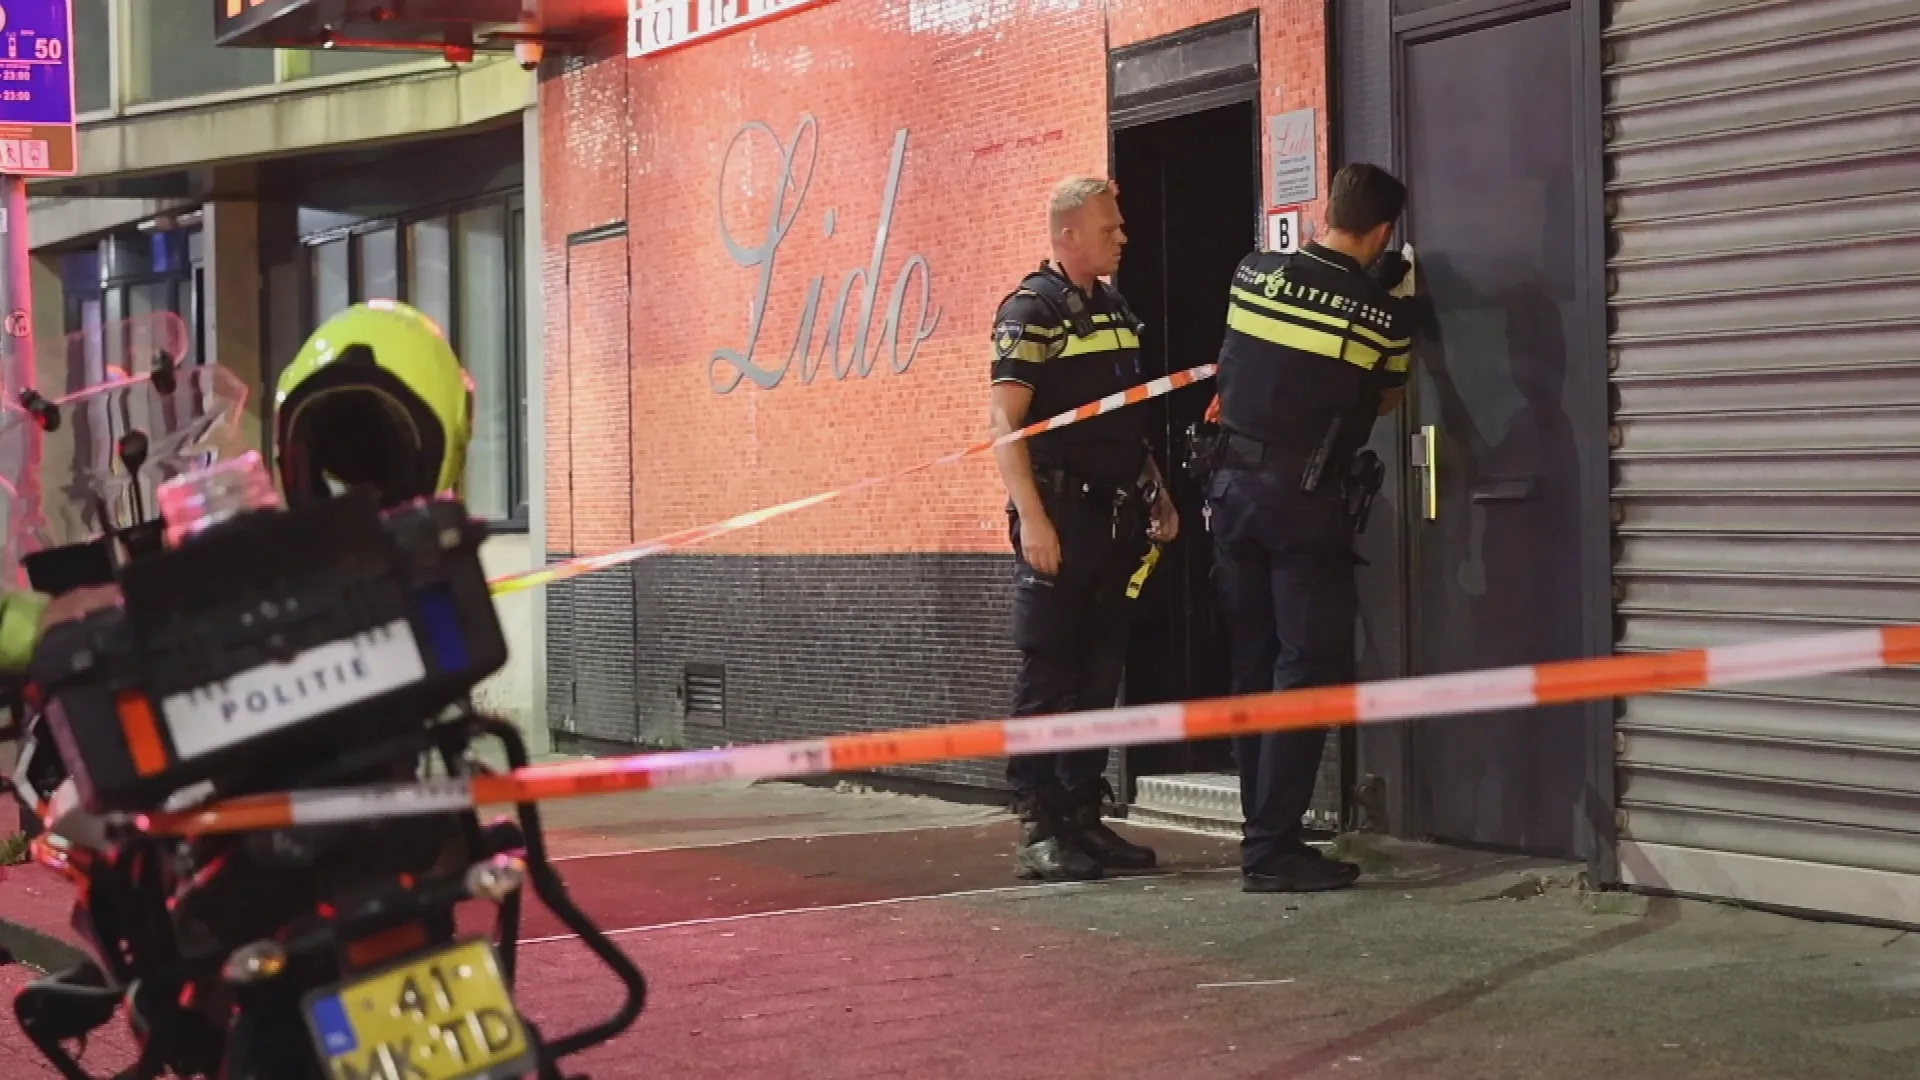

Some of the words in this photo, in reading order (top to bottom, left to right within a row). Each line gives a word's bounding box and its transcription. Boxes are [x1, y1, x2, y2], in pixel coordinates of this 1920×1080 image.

[35, 38, 62, 59] 50
[1279, 217, 1290, 249] B
[709, 113, 942, 394] Lido
[1254, 270, 1345, 309] POLITIE
[220, 656, 366, 723] POLITIE
